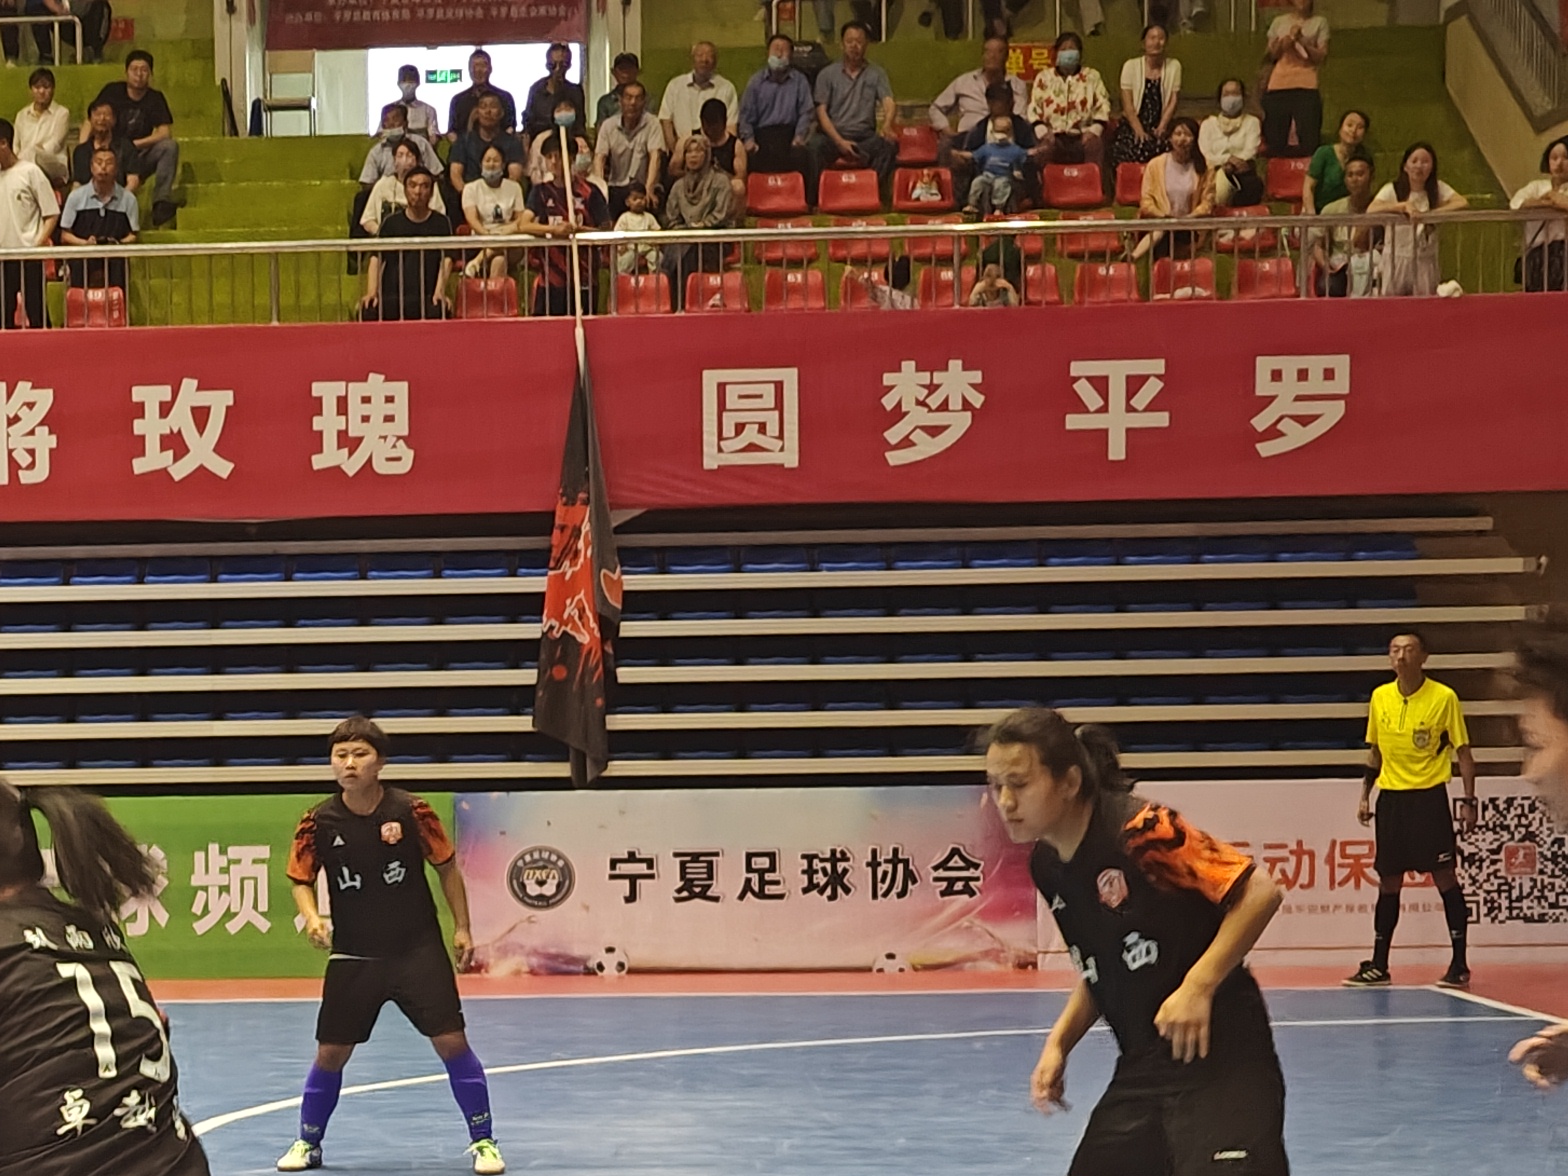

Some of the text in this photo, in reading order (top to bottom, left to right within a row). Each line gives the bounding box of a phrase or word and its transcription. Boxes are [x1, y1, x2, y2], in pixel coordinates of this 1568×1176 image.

[701, 354, 1350, 470] 圆梦平罗
[336, 860, 408, 892] 山西
[607, 844, 985, 904] 宁夏足球协会
[56, 961, 170, 1083] 15
